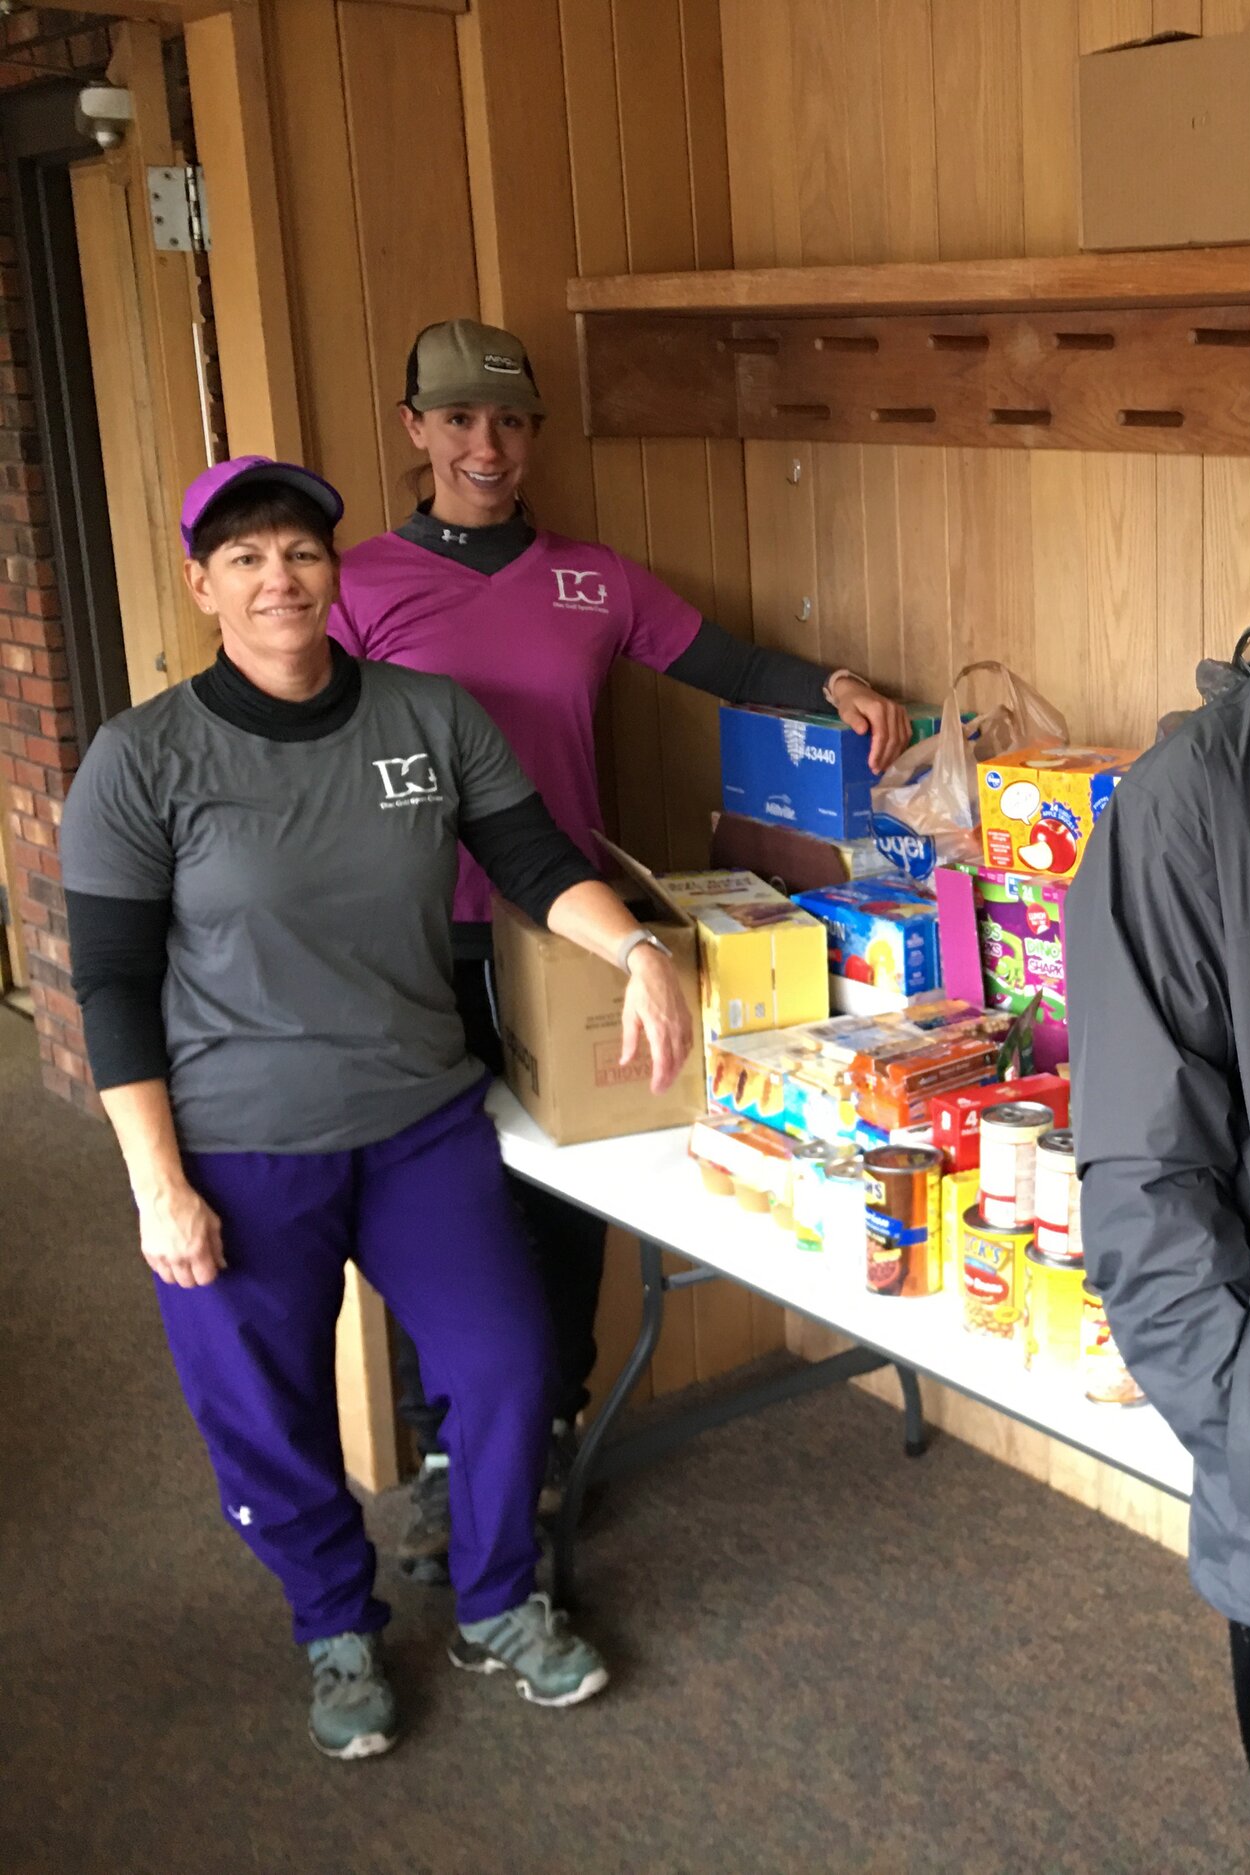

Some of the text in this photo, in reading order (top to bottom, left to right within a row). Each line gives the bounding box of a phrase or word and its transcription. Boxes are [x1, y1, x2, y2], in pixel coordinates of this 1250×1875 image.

[804, 745, 836, 765] 43440
[873, 836, 925, 873] oger
[1024, 937, 1062, 958] DINO
[1028, 958, 1063, 978] SHARK
[598, 1064, 653, 1086] RAGILE
[965, 1110, 978, 1126] 4
